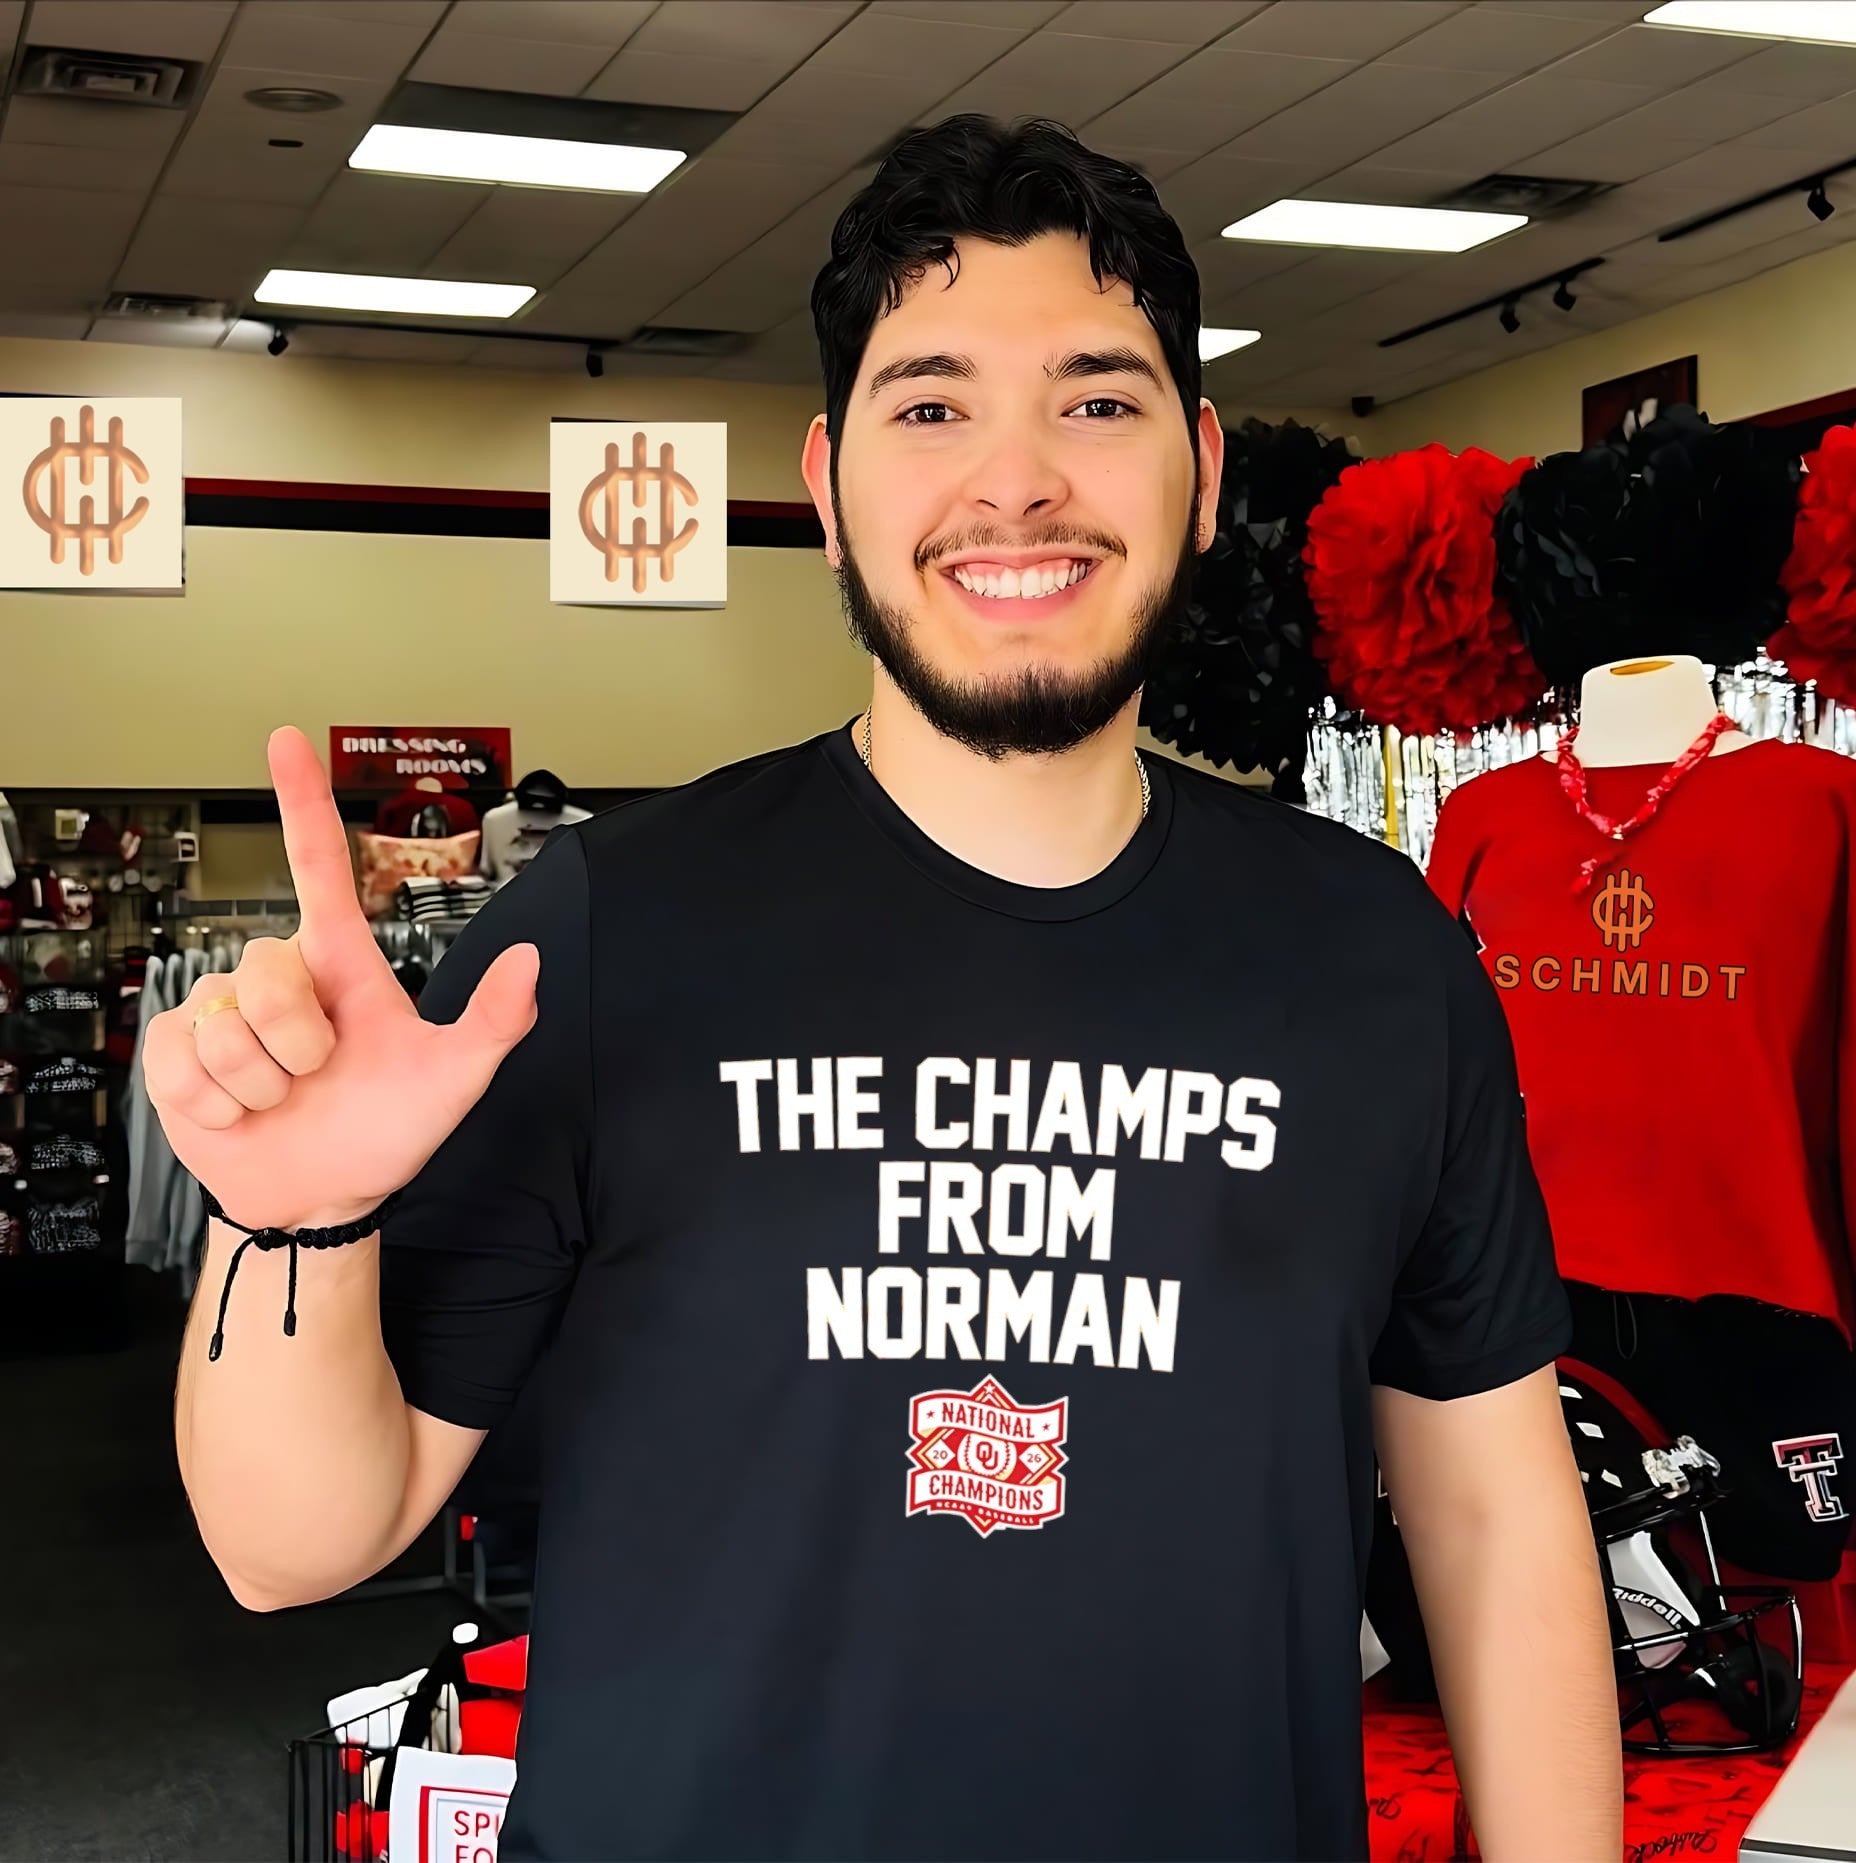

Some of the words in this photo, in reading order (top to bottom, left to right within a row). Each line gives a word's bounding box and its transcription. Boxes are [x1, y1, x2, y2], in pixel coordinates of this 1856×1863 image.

[395, 758, 487, 775] ROOMS
[1494, 954, 1746, 1000] SCHMIDT
[719, 1056, 885, 1154] THE
[915, 1056, 1282, 1172] CHAMPS
[878, 1160, 1117, 1262] FROM
[806, 1266, 1182, 1374] NORMAN
[941, 1402, 1035, 1439] NATIONAL
[932, 1449, 948, 1460] 20
[975, 1441, 999, 1471] OU
[1026, 1453, 1042, 1464] 26
[928, 1474, 1044, 1511] CHAMPIONS
[977, 1508, 1035, 1524] BASEBALL
